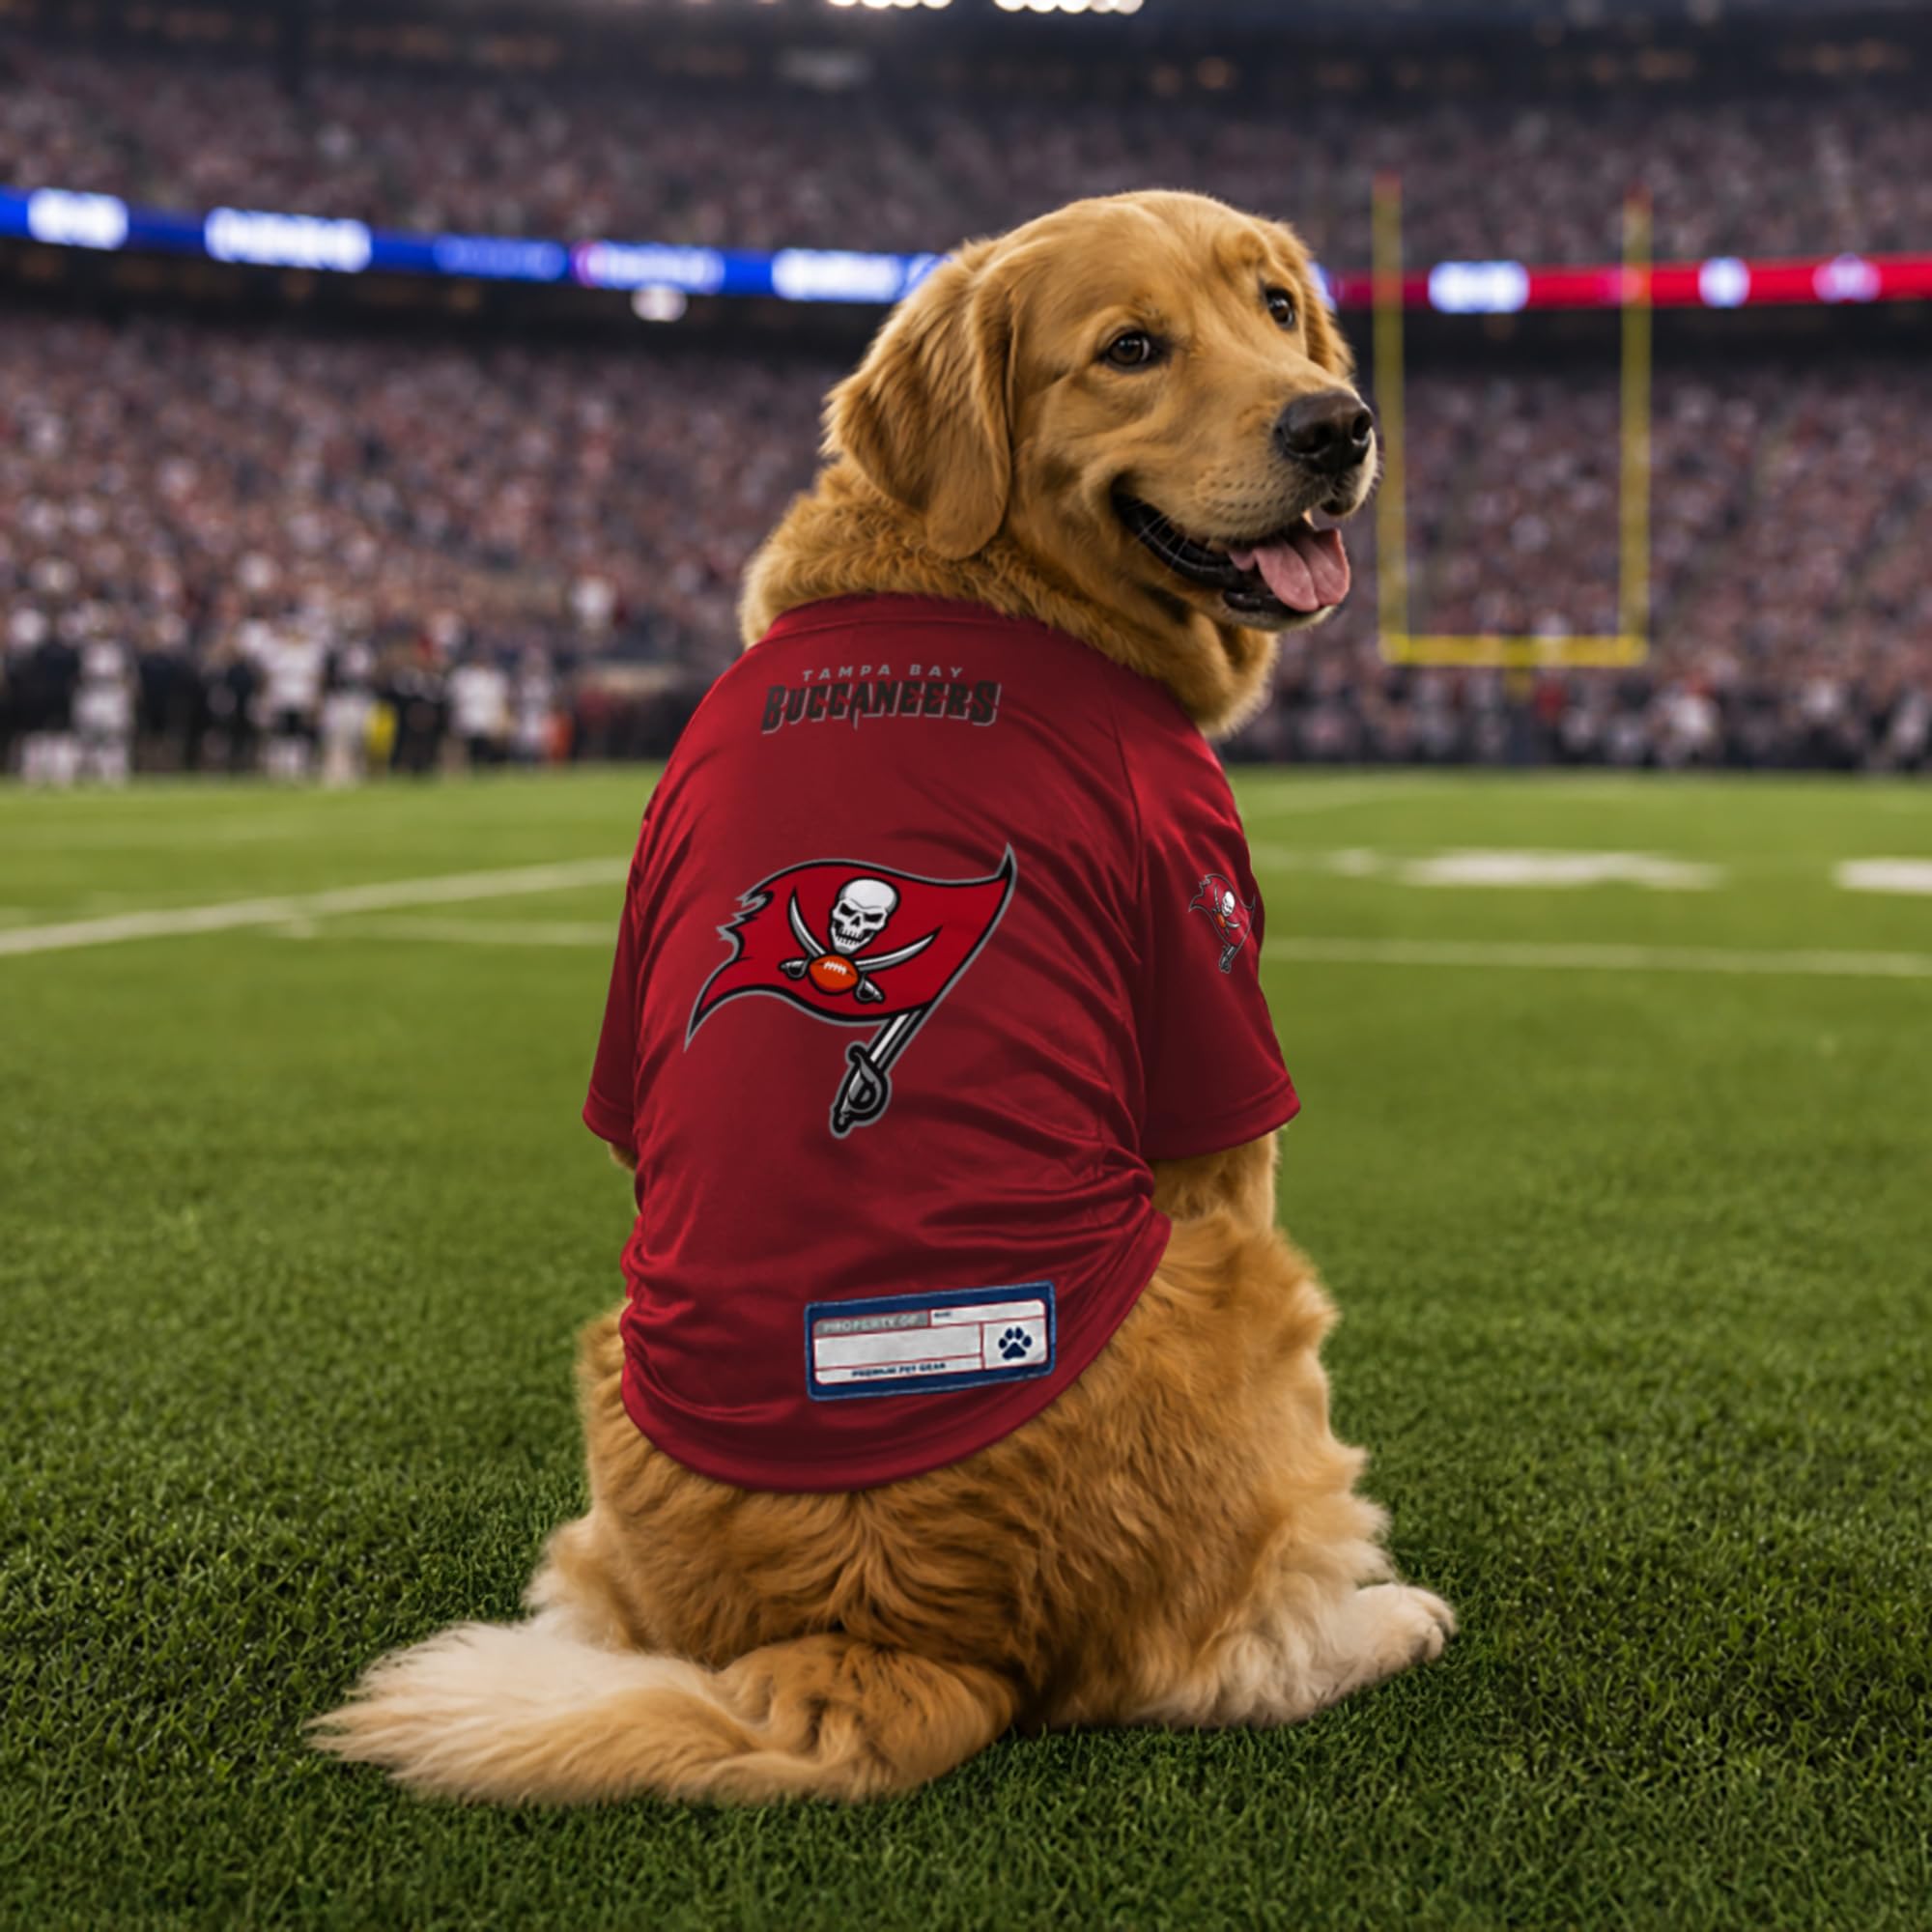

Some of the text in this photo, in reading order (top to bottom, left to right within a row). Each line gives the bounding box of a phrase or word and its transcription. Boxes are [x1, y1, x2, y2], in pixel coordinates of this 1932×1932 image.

[803, 664, 963, 682] TAMPA BAY
[761, 680, 1002, 734] BUCCANEERS
[823, 1319, 896, 1333] PROPERTY
